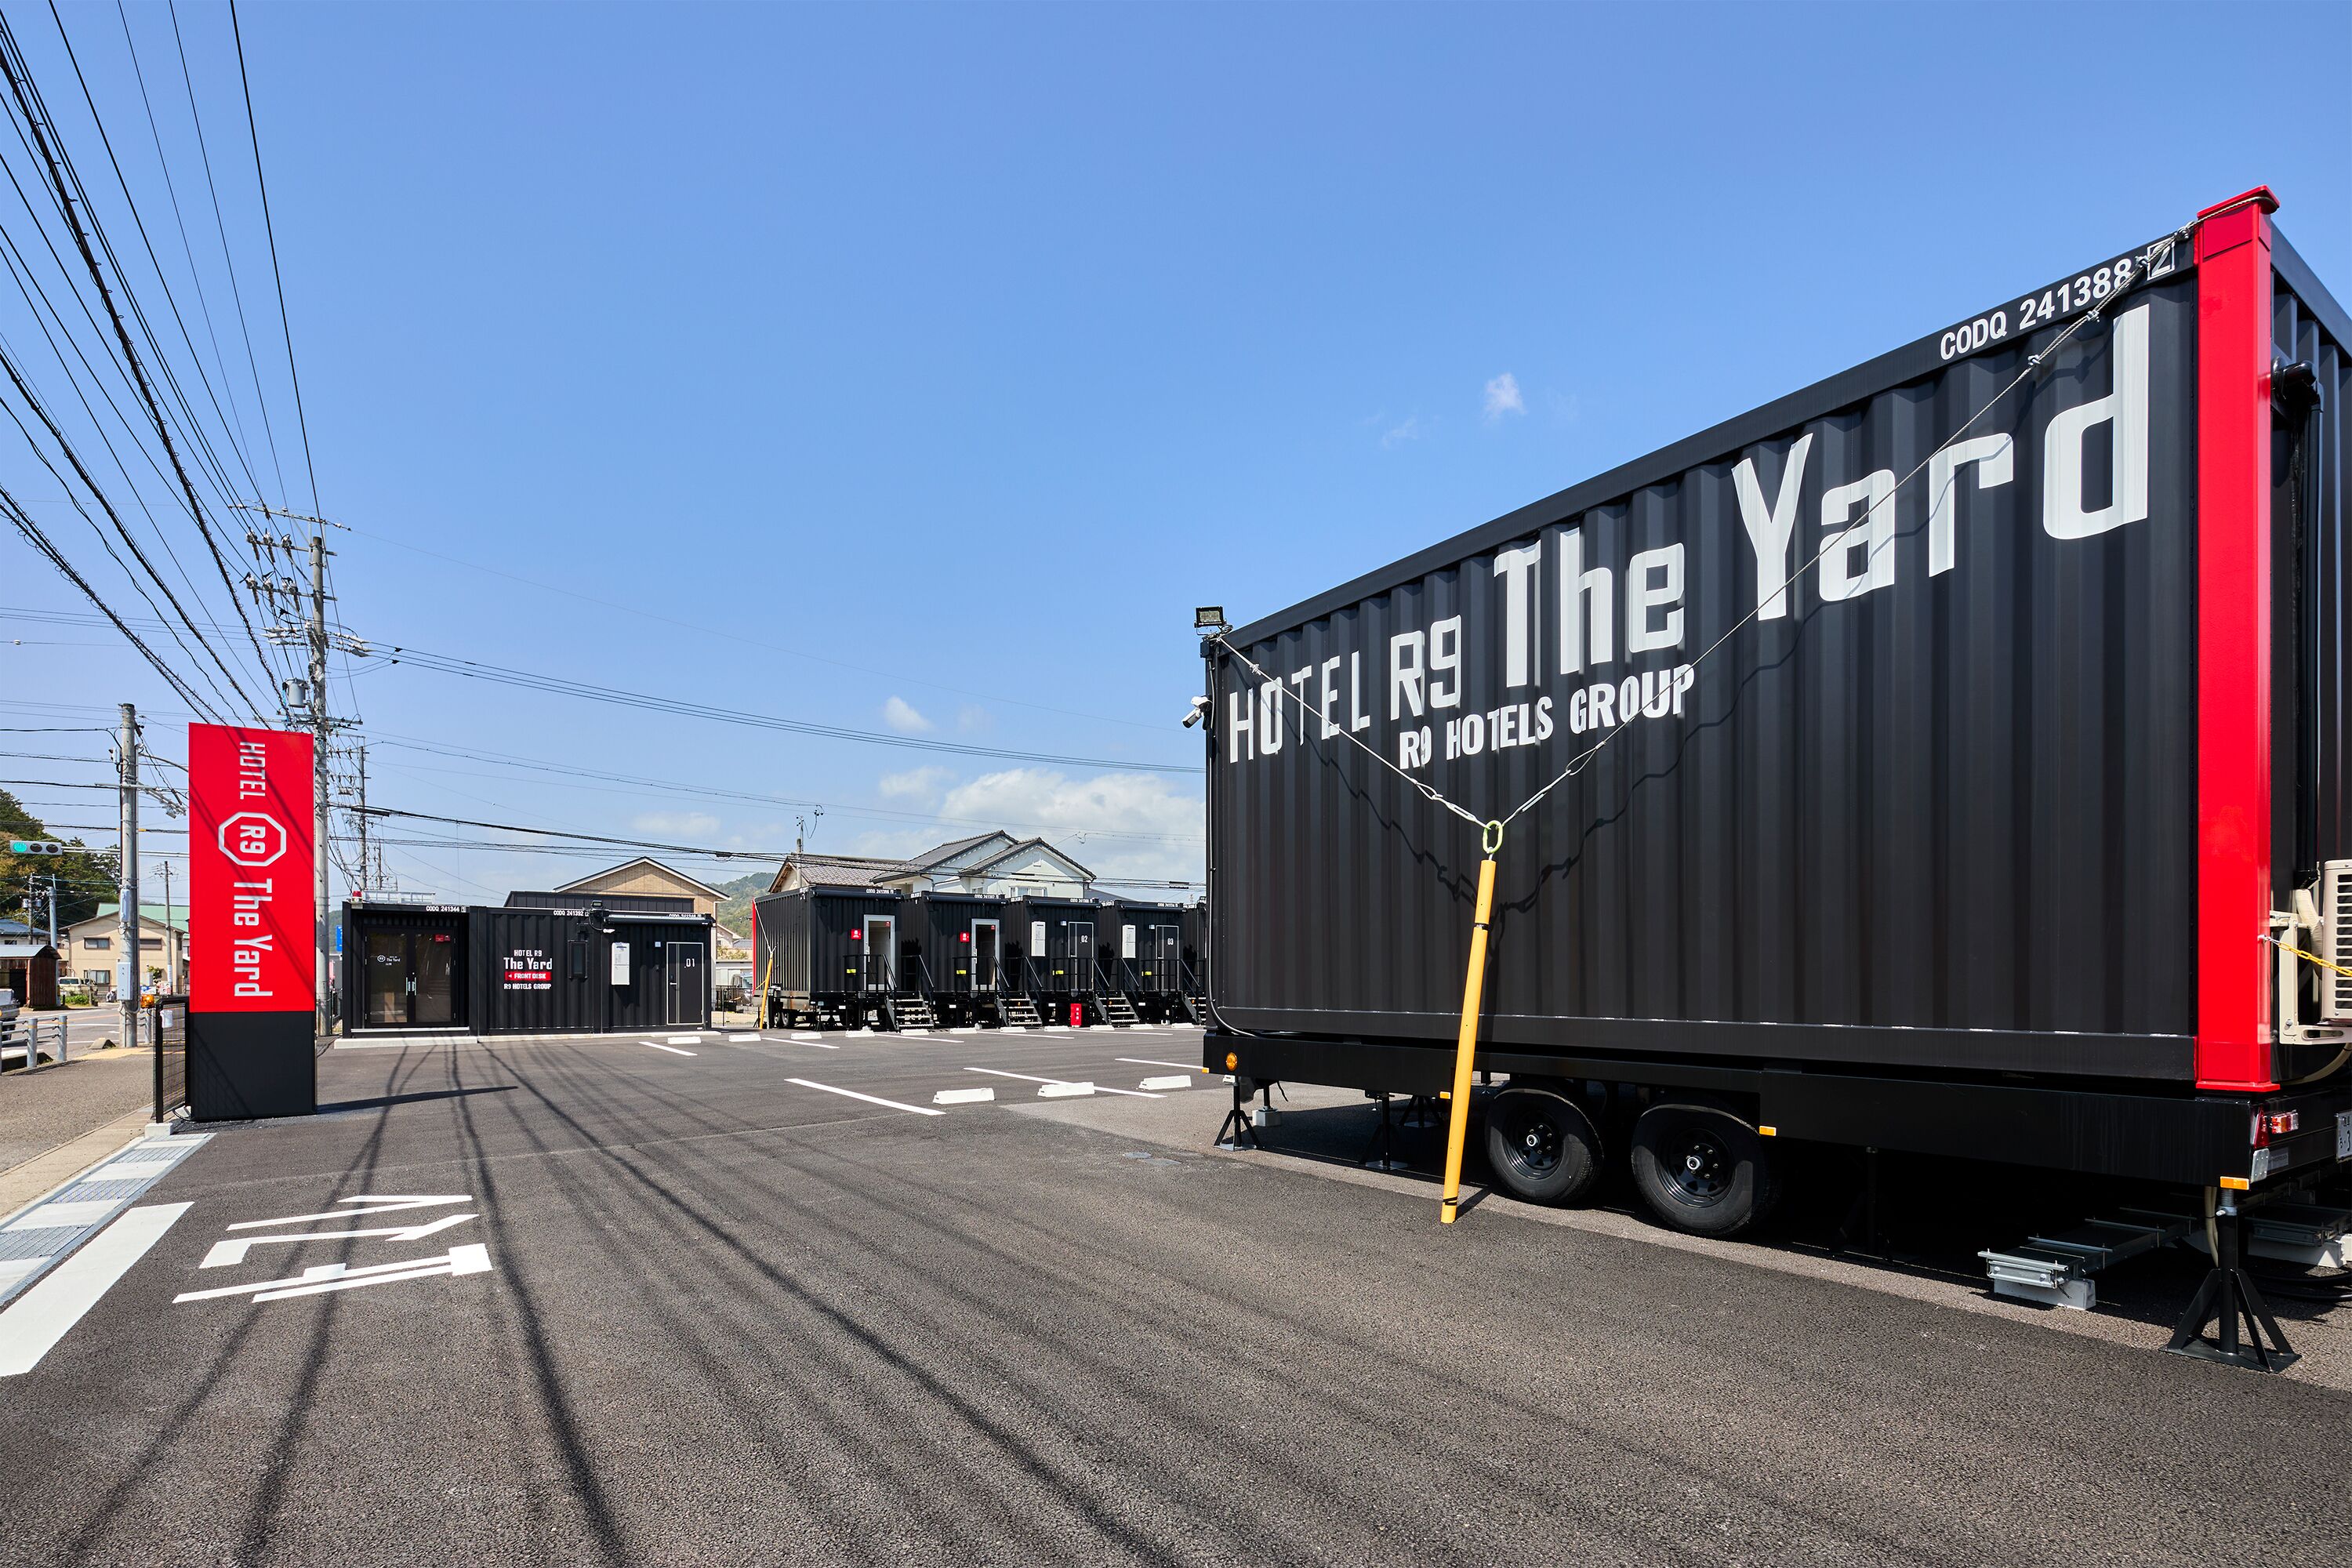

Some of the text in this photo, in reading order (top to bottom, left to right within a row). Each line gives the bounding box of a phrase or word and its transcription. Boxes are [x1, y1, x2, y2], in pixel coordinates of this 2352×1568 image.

[1940, 310, 2008, 361] CODQ
[2020, 257, 2132, 330] 241388
[1229, 303, 2150, 764] HOTEL R9 The Yard
[1399, 663, 1695, 770] R9 HOTELS GROUP
[234, 742, 274, 996] HOTEL R9 The Yard
[503, 956, 553, 970] The Yard
